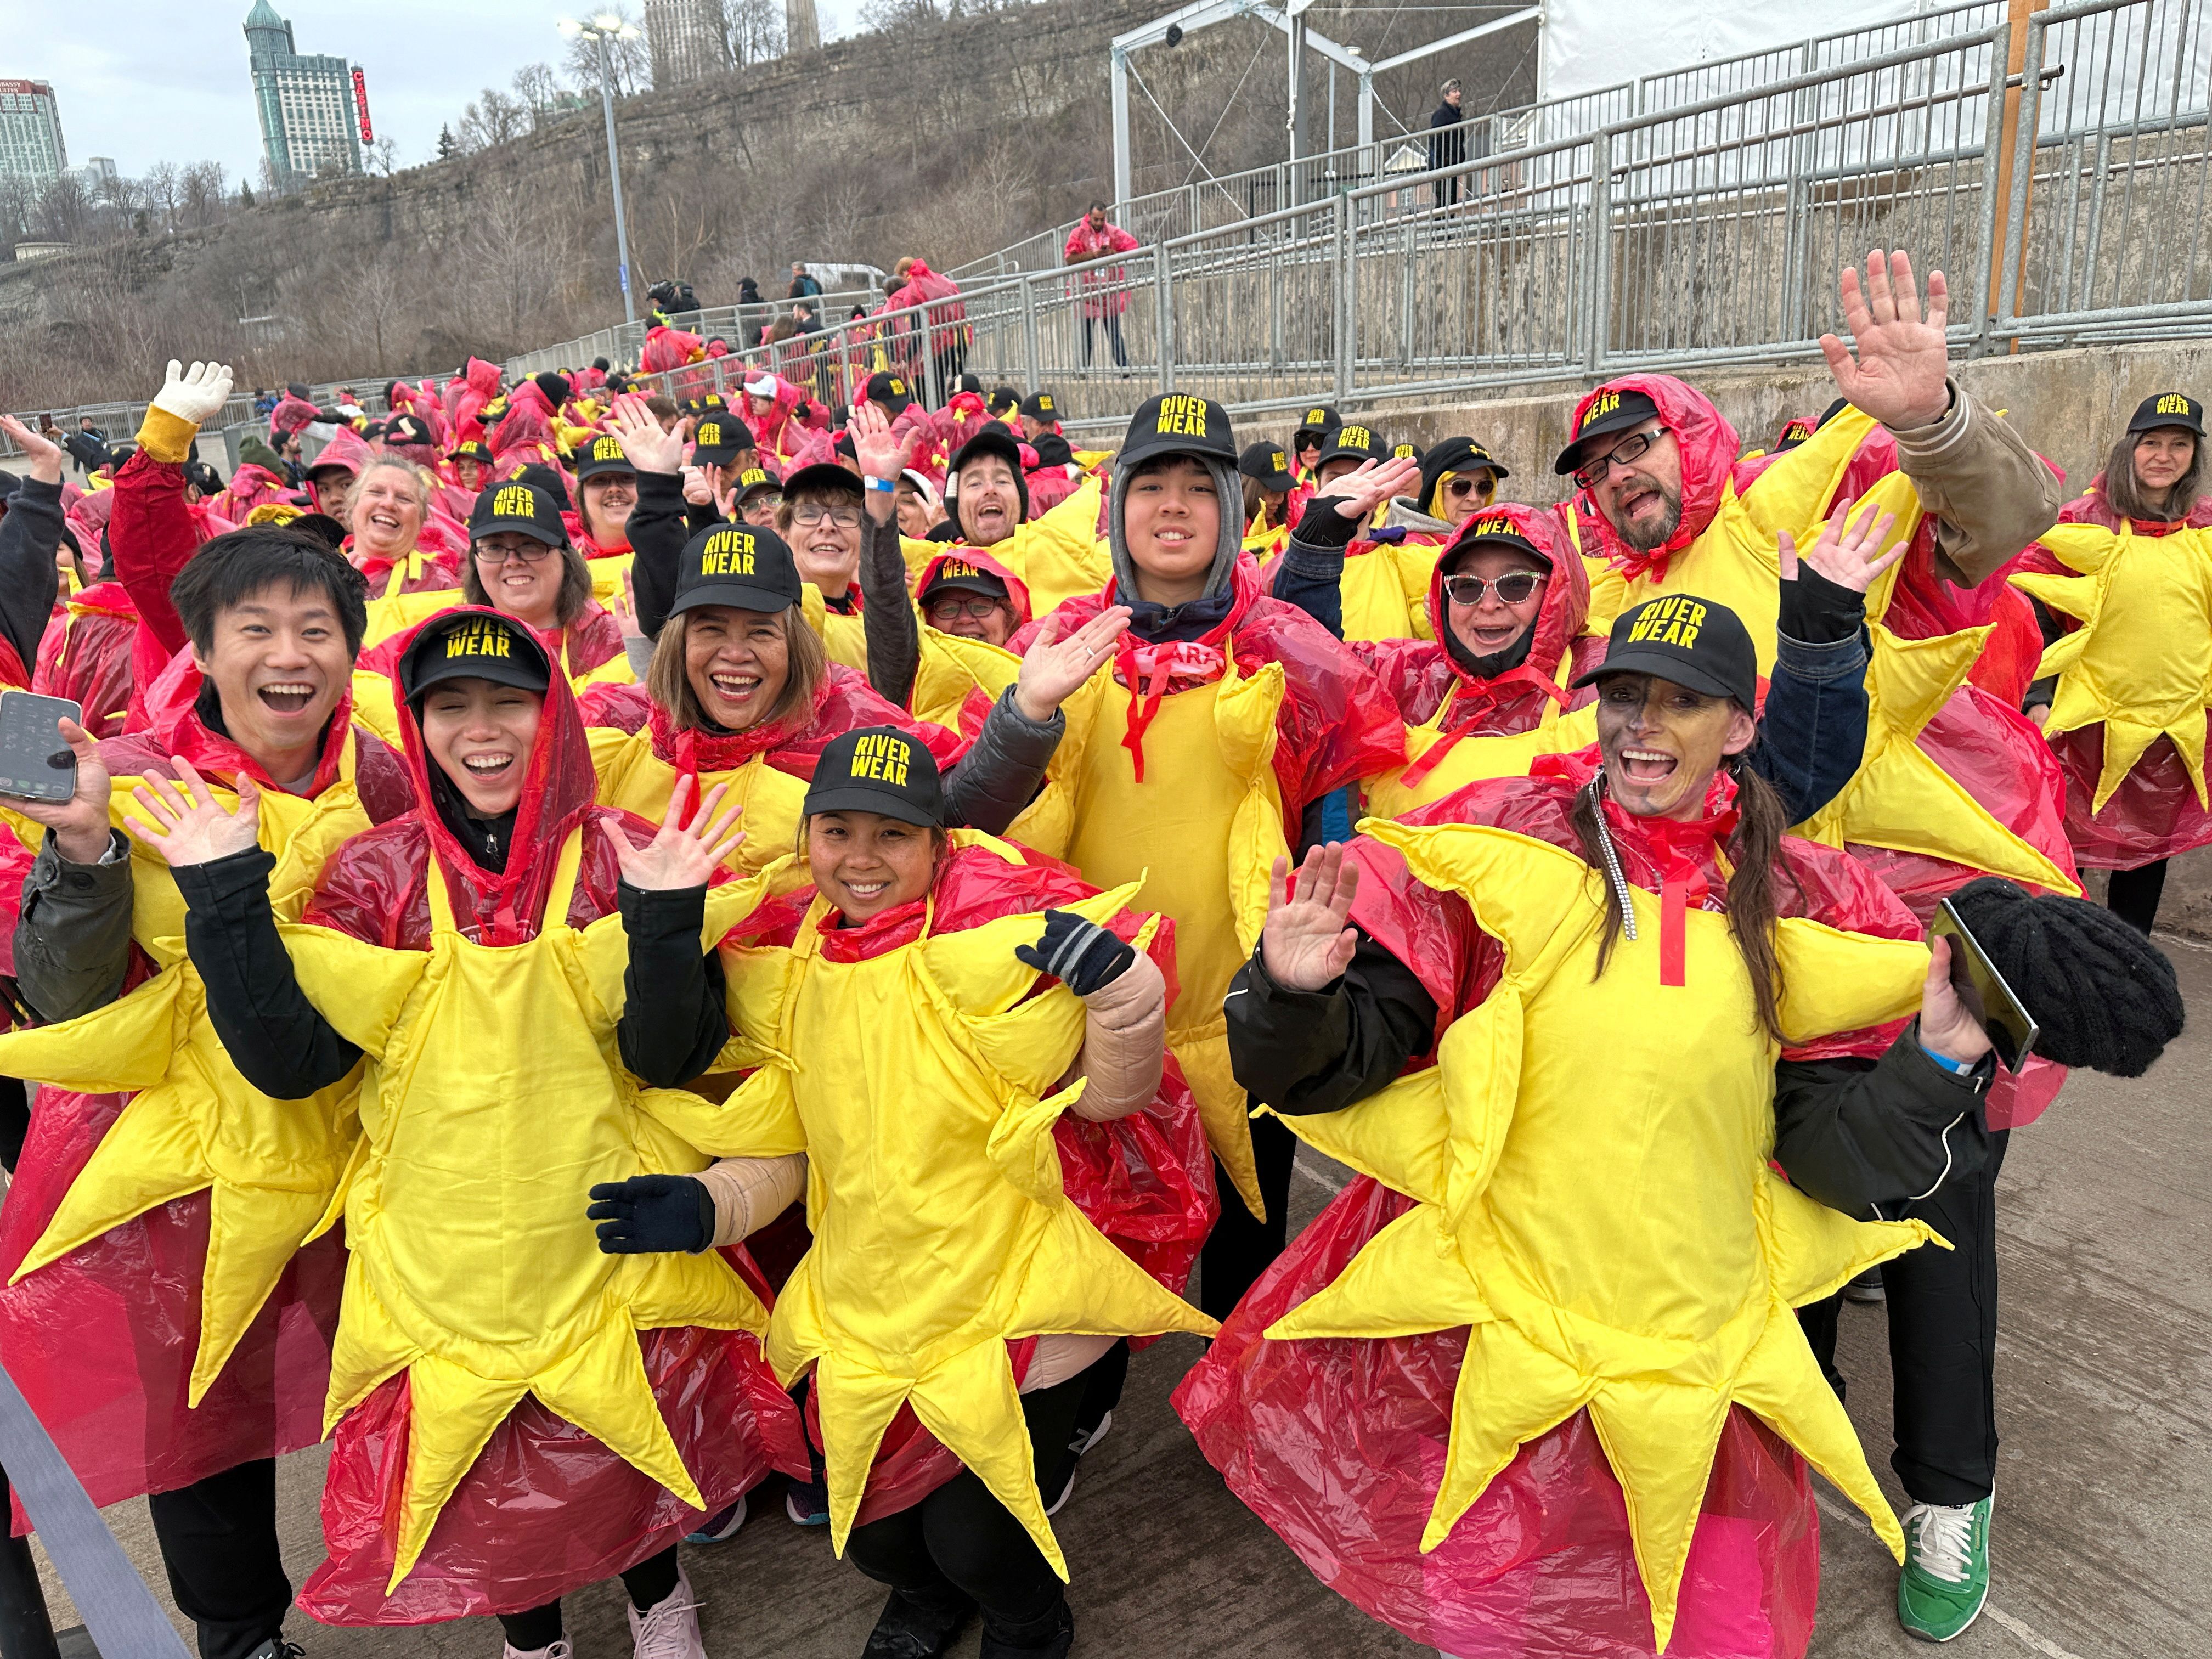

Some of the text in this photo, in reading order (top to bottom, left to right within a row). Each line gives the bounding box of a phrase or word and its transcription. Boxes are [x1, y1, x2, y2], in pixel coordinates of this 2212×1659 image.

[354, 71, 371, 140] CASINO
[1160, 395, 1207, 420] RIVER
[1583, 394, 1620, 428] WEAR
[2157, 402, 2189, 415] WEAR
[699, 422, 720, 434] RIVER
[1157, 414, 1206, 438] WEAR
[1340, 425, 1370, 441] RIVER
[594, 436, 620, 449] RIVER
[699, 432, 721, 445] WEAR
[1338, 435, 1370, 450] WEAR
[1395, 444, 1413, 453] RIVER
[594, 447, 624, 461] WEAR
[495, 486, 534, 503] RIVER
[494, 499, 534, 518] WEAR
[703, 531, 755, 555] RIVER
[702, 552, 755, 575] WEAR
[943, 563, 979, 580] WEAR
[1637, 597, 1707, 627] RIVER
[1627, 619, 1699, 650] WEAR
[447, 635, 510, 658] WEAR
[855, 735, 910, 765] RIVER
[851, 755, 907, 787] WEAR
